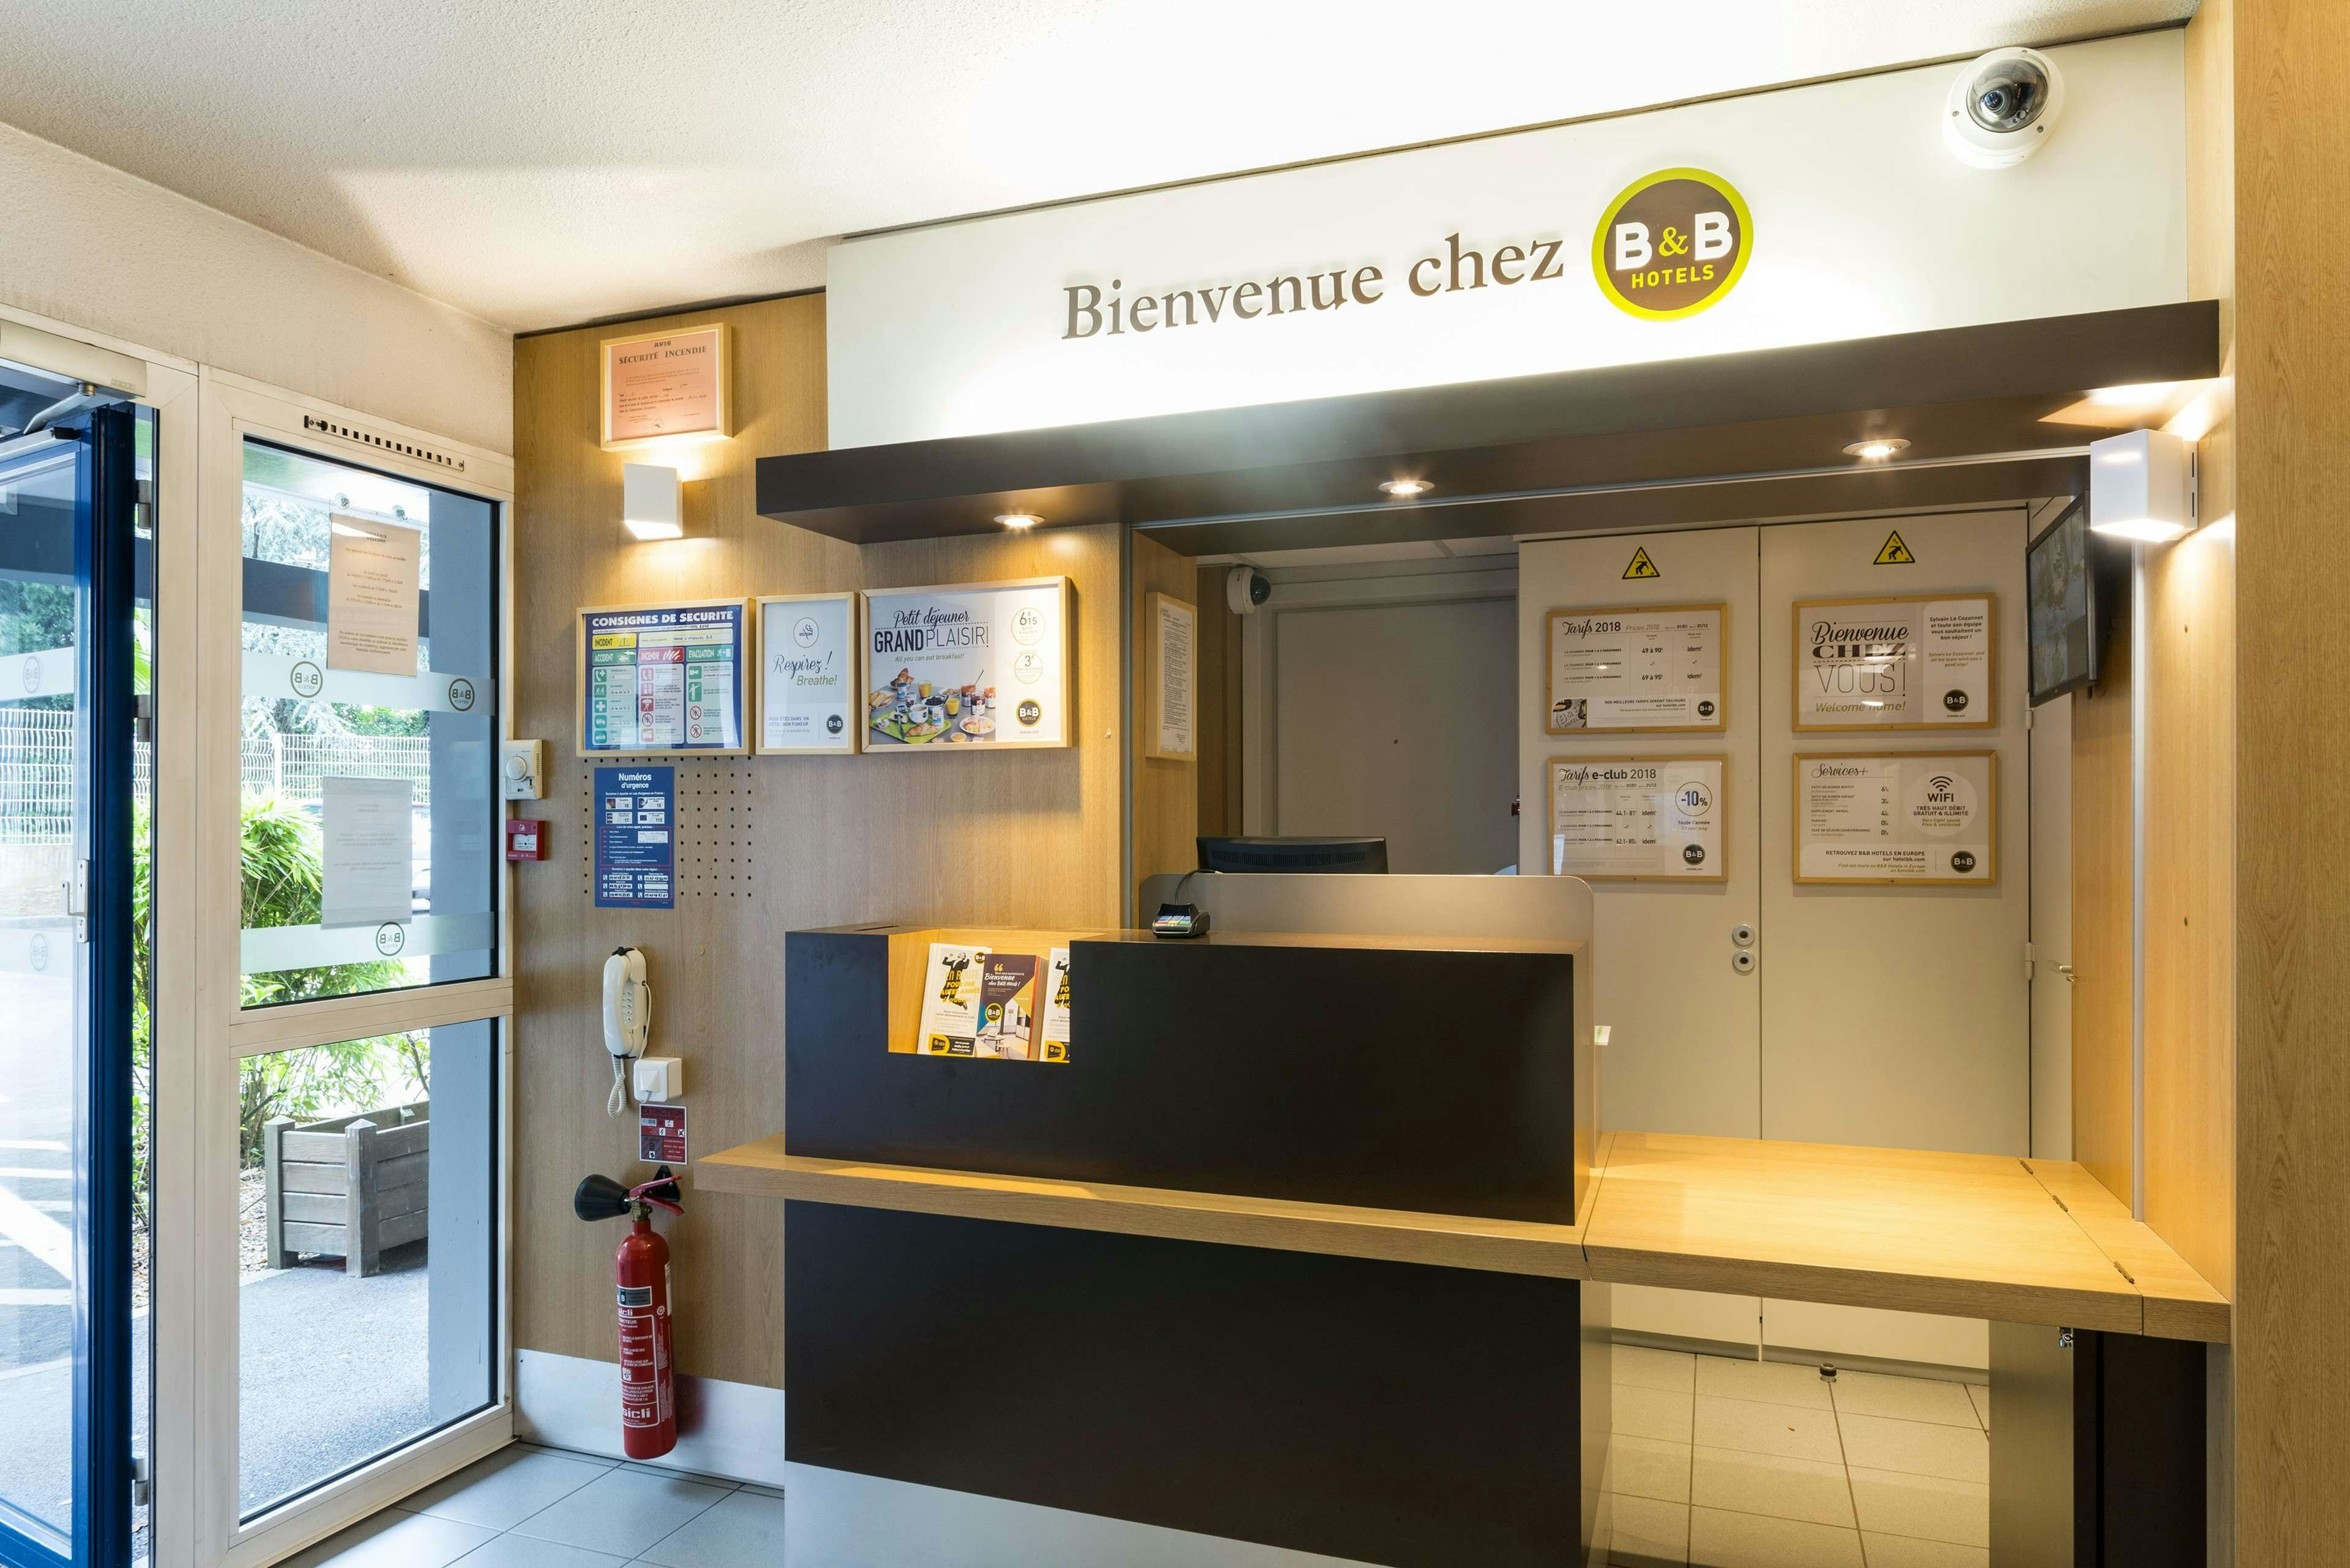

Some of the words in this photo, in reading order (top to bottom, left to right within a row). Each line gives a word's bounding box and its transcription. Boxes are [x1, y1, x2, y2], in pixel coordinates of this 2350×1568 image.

[1615, 211, 1733, 271] B&B
[1631, 264, 1715, 289] HOTELS
[1062, 265, 1384, 340] Bienvenue
[1408, 232, 1564, 297] chez
[665, 345, 707, 358] INCENDIE
[592, 614, 658, 627] CONSIGNES
[662, 614, 676, 622] DE
[680, 611, 733, 622] SECURITE
[893, 609, 922, 628] Petit
[923, 607, 969, 631] déjeuner
[1562, 619, 1592, 639] Tarifs
[1595, 622, 1621, 632] 2018
[1811, 621, 1909, 644] Bienvenue
[594, 653, 613, 662] ACCIDENT
[688, 649, 714, 658] EVACUATION
[1813, 643, 1906, 659] CHEZ
[773, 654, 822, 679] Respirez
[825, 651, 833, 670] !
[797, 674, 837, 685] Breathe!
[1813, 662, 1906, 696] VOUS!
[1020, 707, 1039, 717] B&B
[1816, 703, 1865, 712] Welcome
[1559, 766, 1589, 786] Tarifs
[1592, 769, 1628, 779] e-club
[1630, 769, 1656, 778] 2018
[1811, 763, 1868, 778] Services+
[1928, 793, 1953, 802] WIFI
[642, 1107, 684, 1116] EXTINCTEUR
[623, 1408, 651, 1418] sicli
